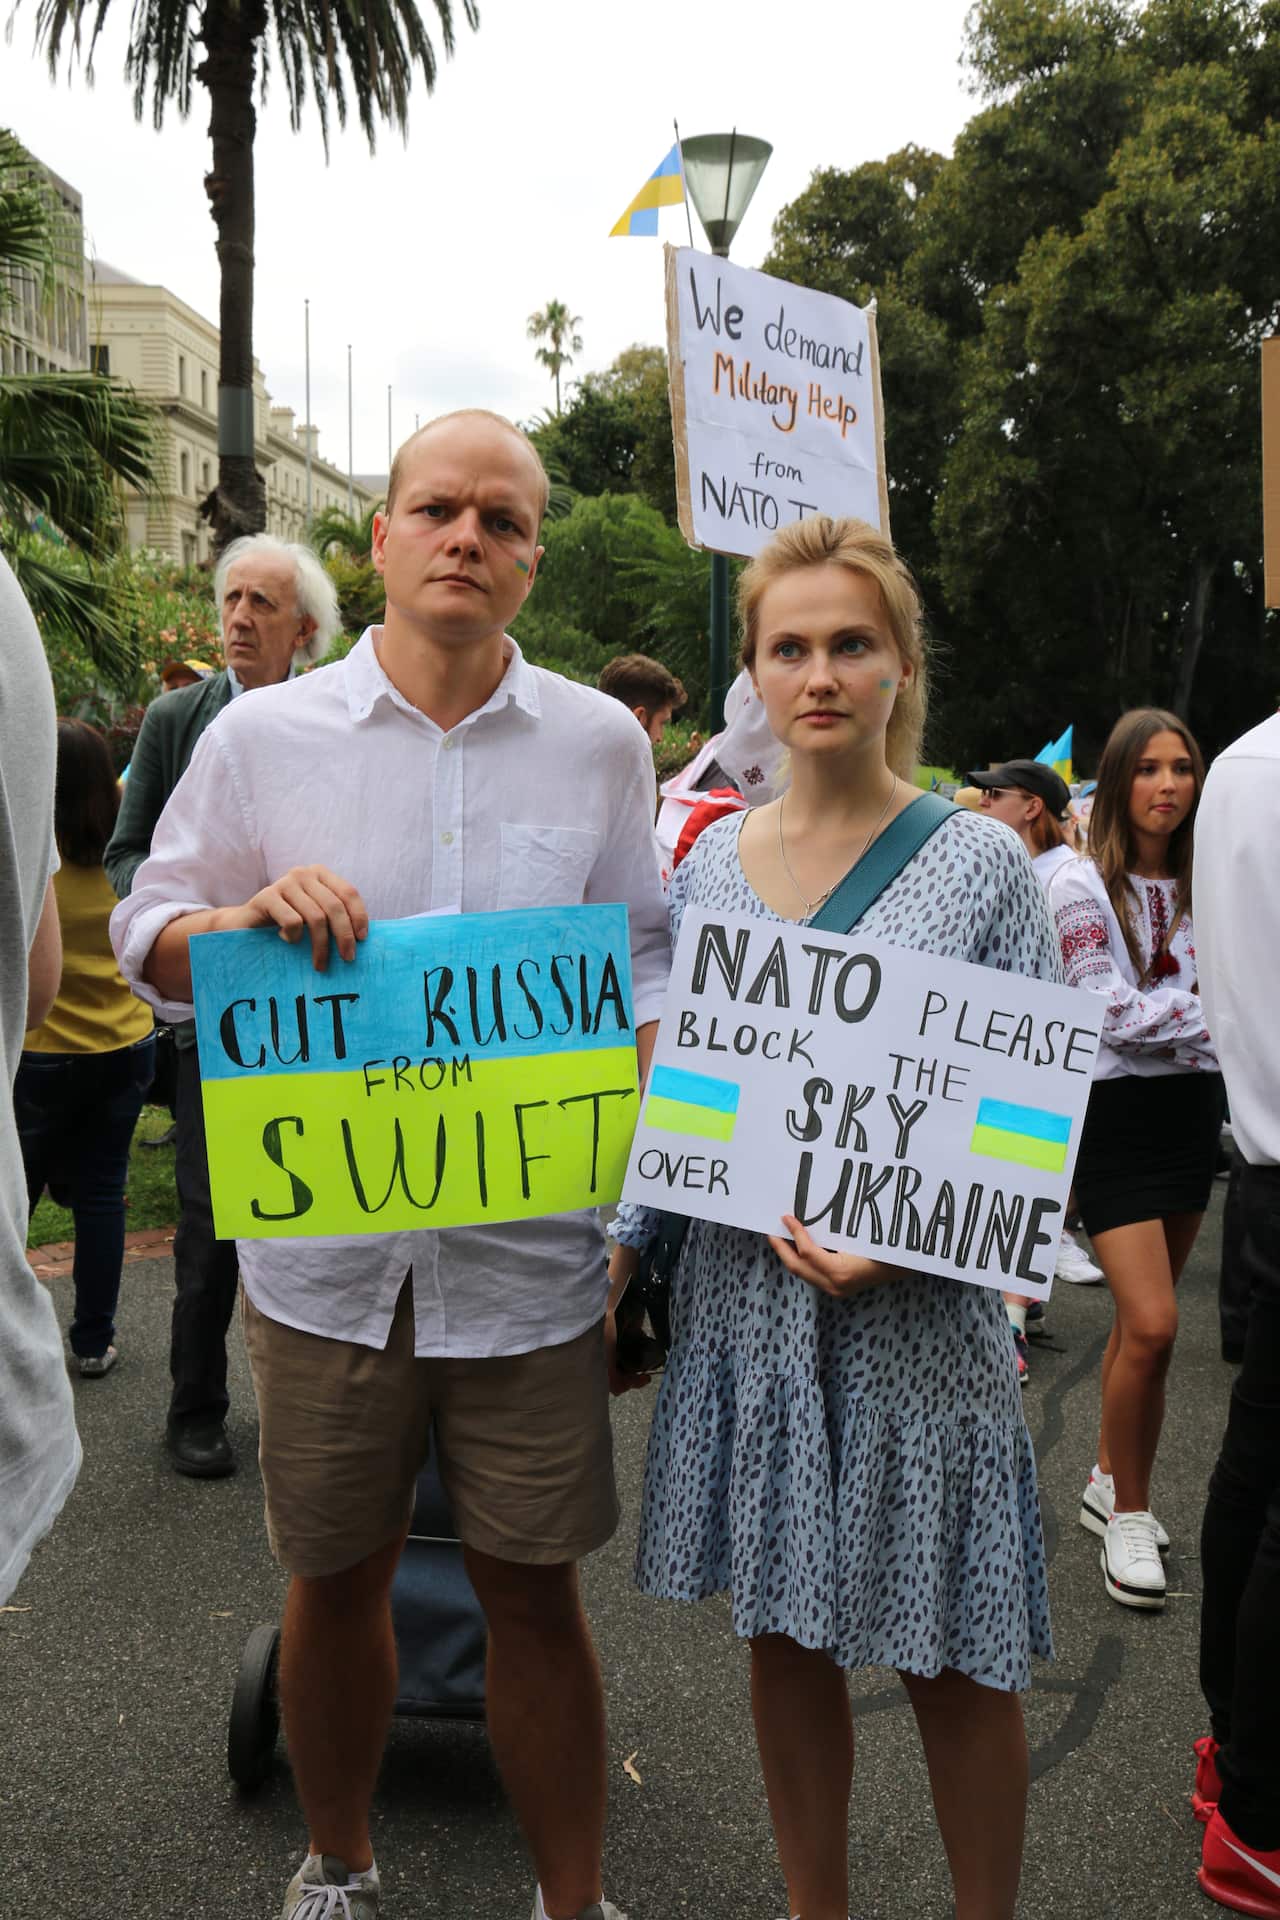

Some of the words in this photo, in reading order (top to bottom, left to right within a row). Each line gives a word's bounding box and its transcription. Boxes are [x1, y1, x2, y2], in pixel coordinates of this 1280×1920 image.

[689, 266, 743, 340] We
[764, 304, 863, 376] demand
[713, 352, 797, 433] Military
[807, 382, 857, 438] Help
[701, 472, 779, 530] NATO
[750, 452, 804, 483] from
[219, 993, 360, 1068] CUT
[424, 953, 629, 1047] RUSSIA
[691, 924, 882, 1023] NATO
[919, 990, 1097, 1074] PLEASE
[363, 1053, 472, 1096] FROM
[677, 1011, 815, 1068] BLOCK
[889, 1053, 971, 1102] THE
[251, 1088, 635, 1220] SWIFT
[786, 1077, 928, 1159] SKY
[638, 1149, 730, 1196] OVER
[794, 1152, 1062, 1285] UKRAINE
